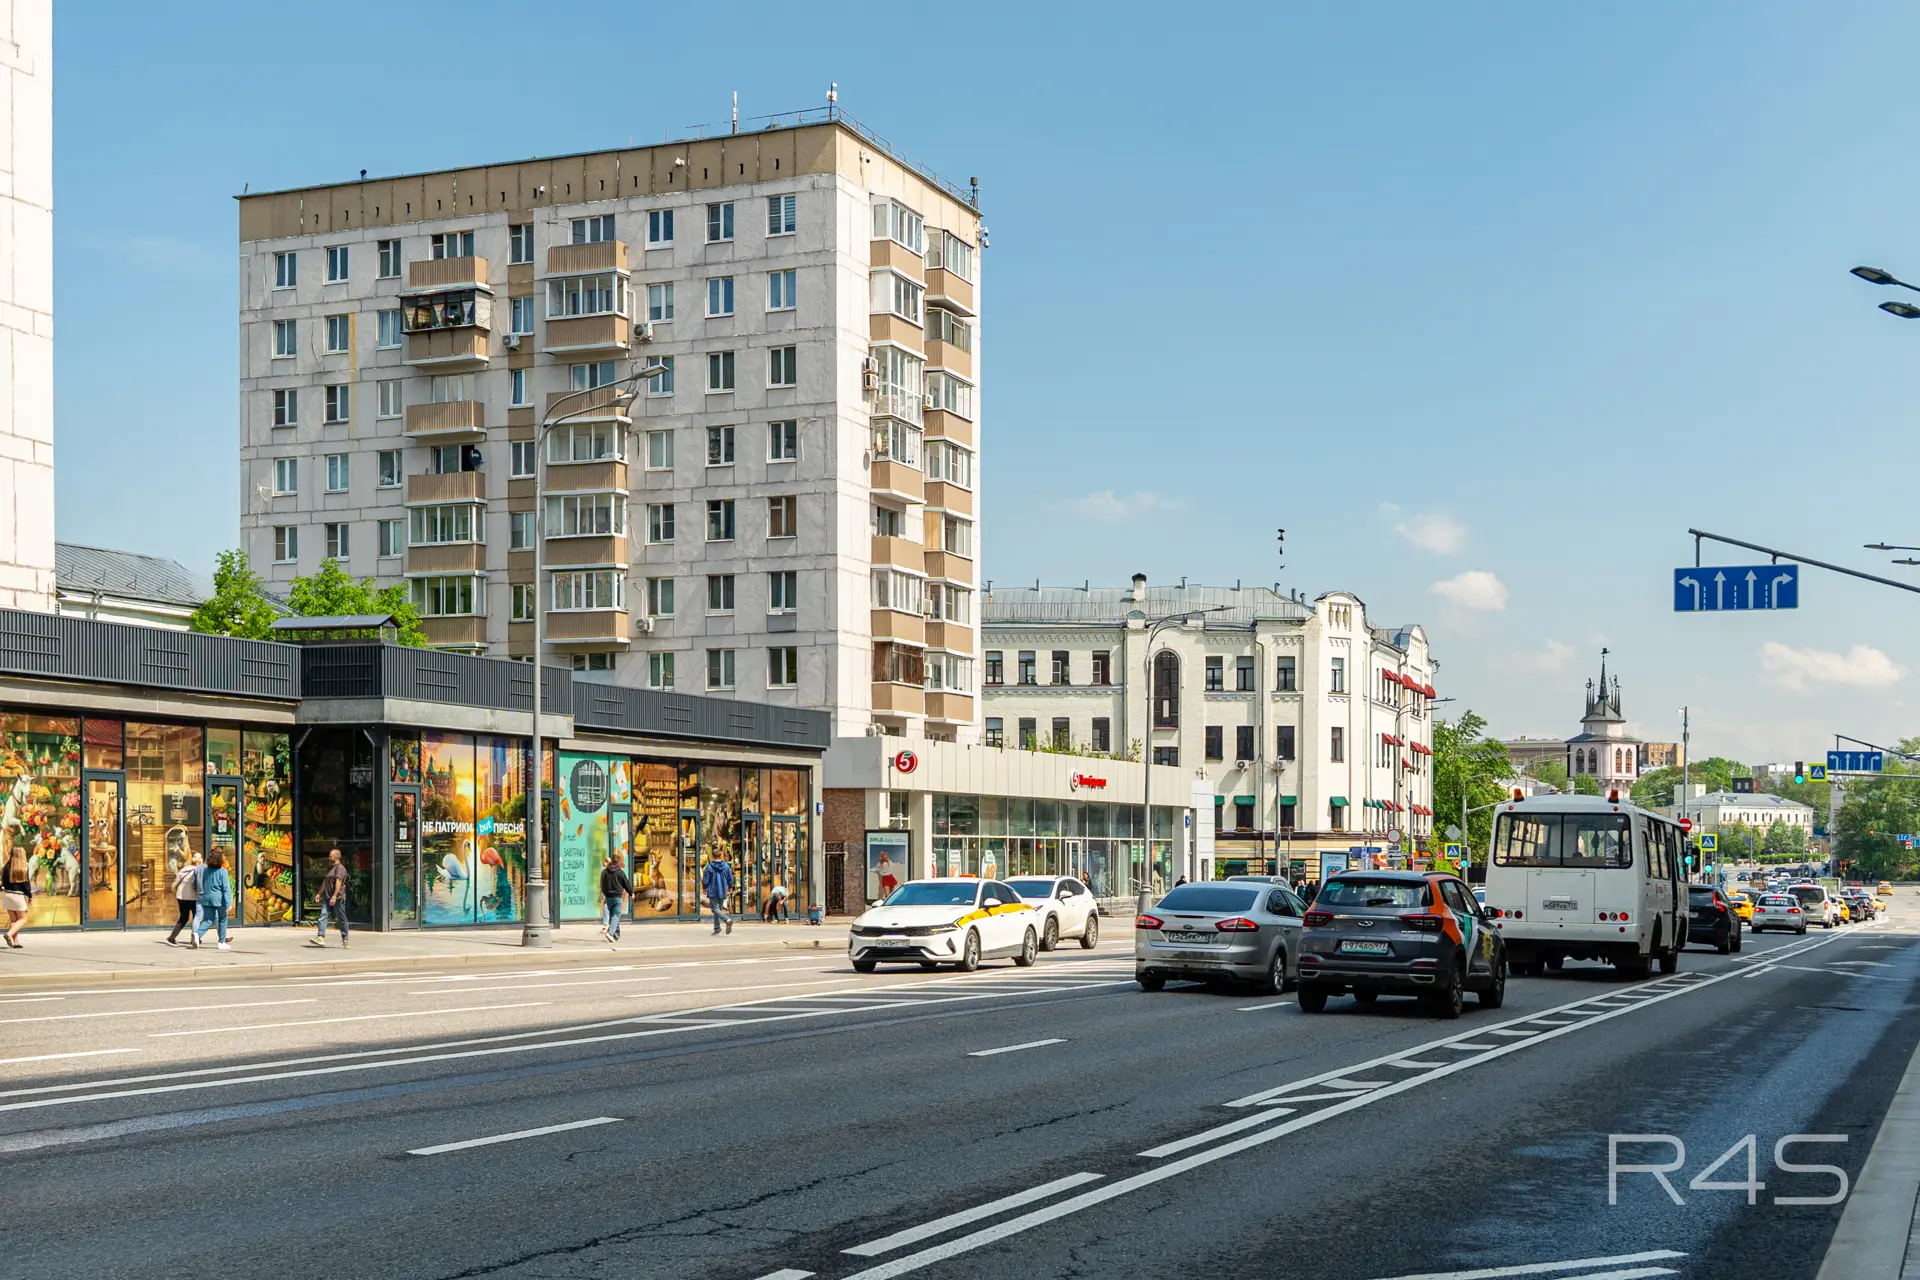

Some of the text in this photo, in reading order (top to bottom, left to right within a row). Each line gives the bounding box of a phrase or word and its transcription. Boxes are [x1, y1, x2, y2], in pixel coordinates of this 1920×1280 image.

[899, 753, 911, 770] 5
[422, 821, 473, 833] НЕ ПАТРИКИ
[479, 820, 492, 832] but
[494, 822, 524, 833] ПРЕСНЯ
